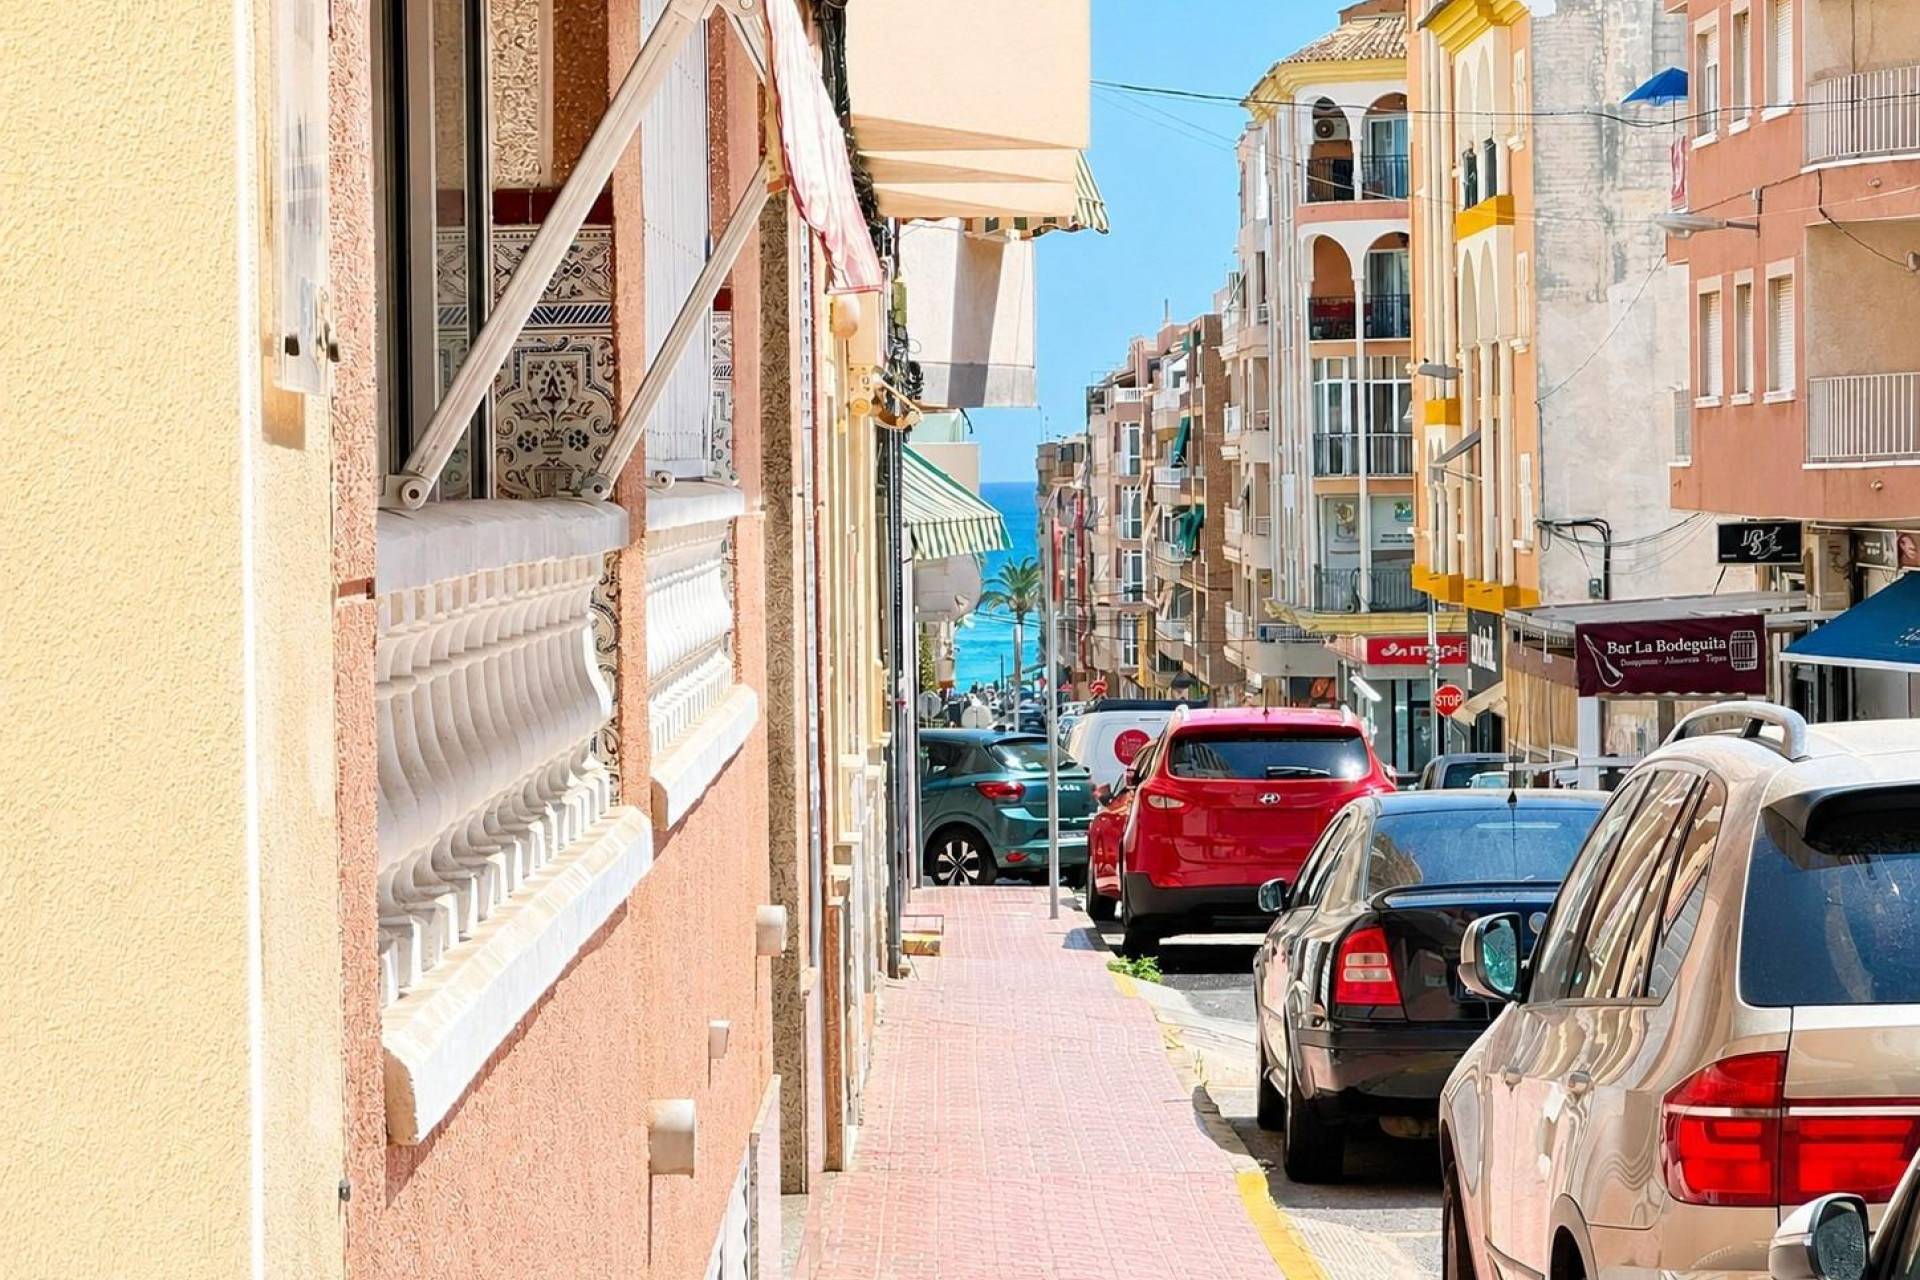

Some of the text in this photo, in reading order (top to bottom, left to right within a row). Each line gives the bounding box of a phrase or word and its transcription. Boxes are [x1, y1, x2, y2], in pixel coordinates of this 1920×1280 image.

[1607, 636, 1726, 655] Bar La Bodeguita
[1435, 694, 1461, 706] STOP
